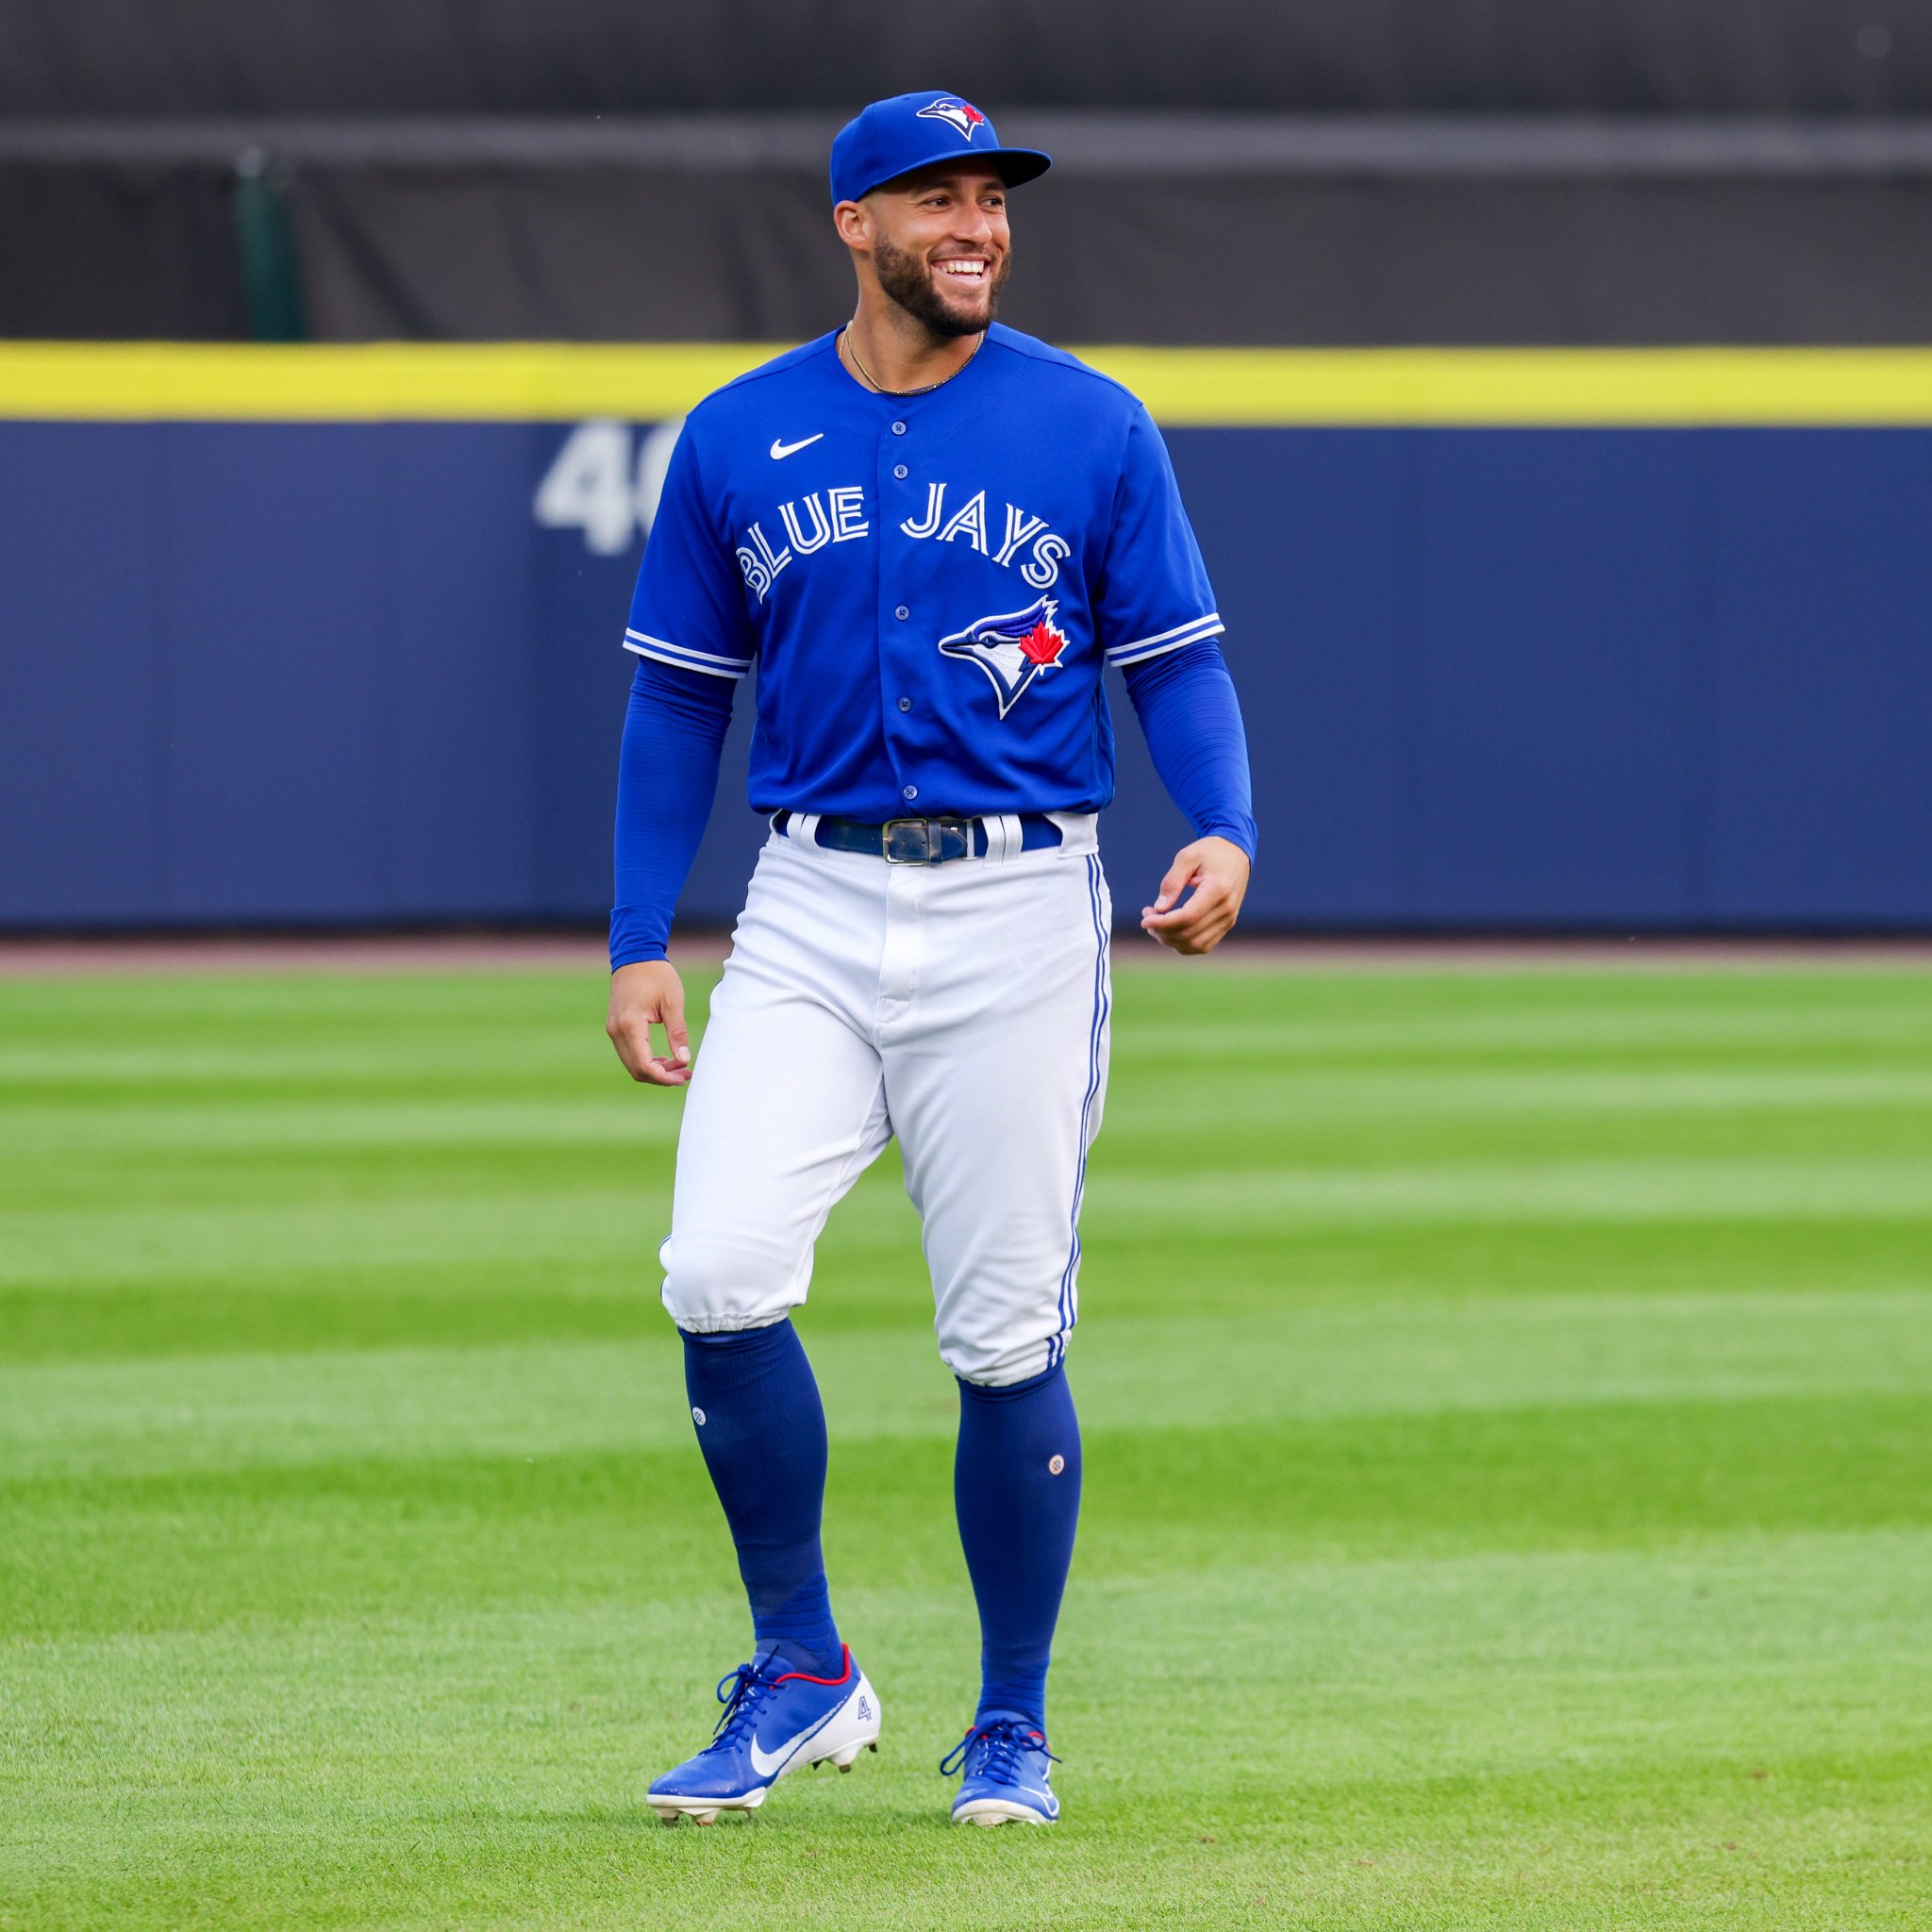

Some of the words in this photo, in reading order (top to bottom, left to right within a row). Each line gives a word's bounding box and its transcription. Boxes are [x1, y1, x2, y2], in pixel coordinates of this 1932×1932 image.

[735, 486, 870, 605] BLUE
[900, 482, 1071, 590] JAYS
[858, 1695, 873, 1722] 4
